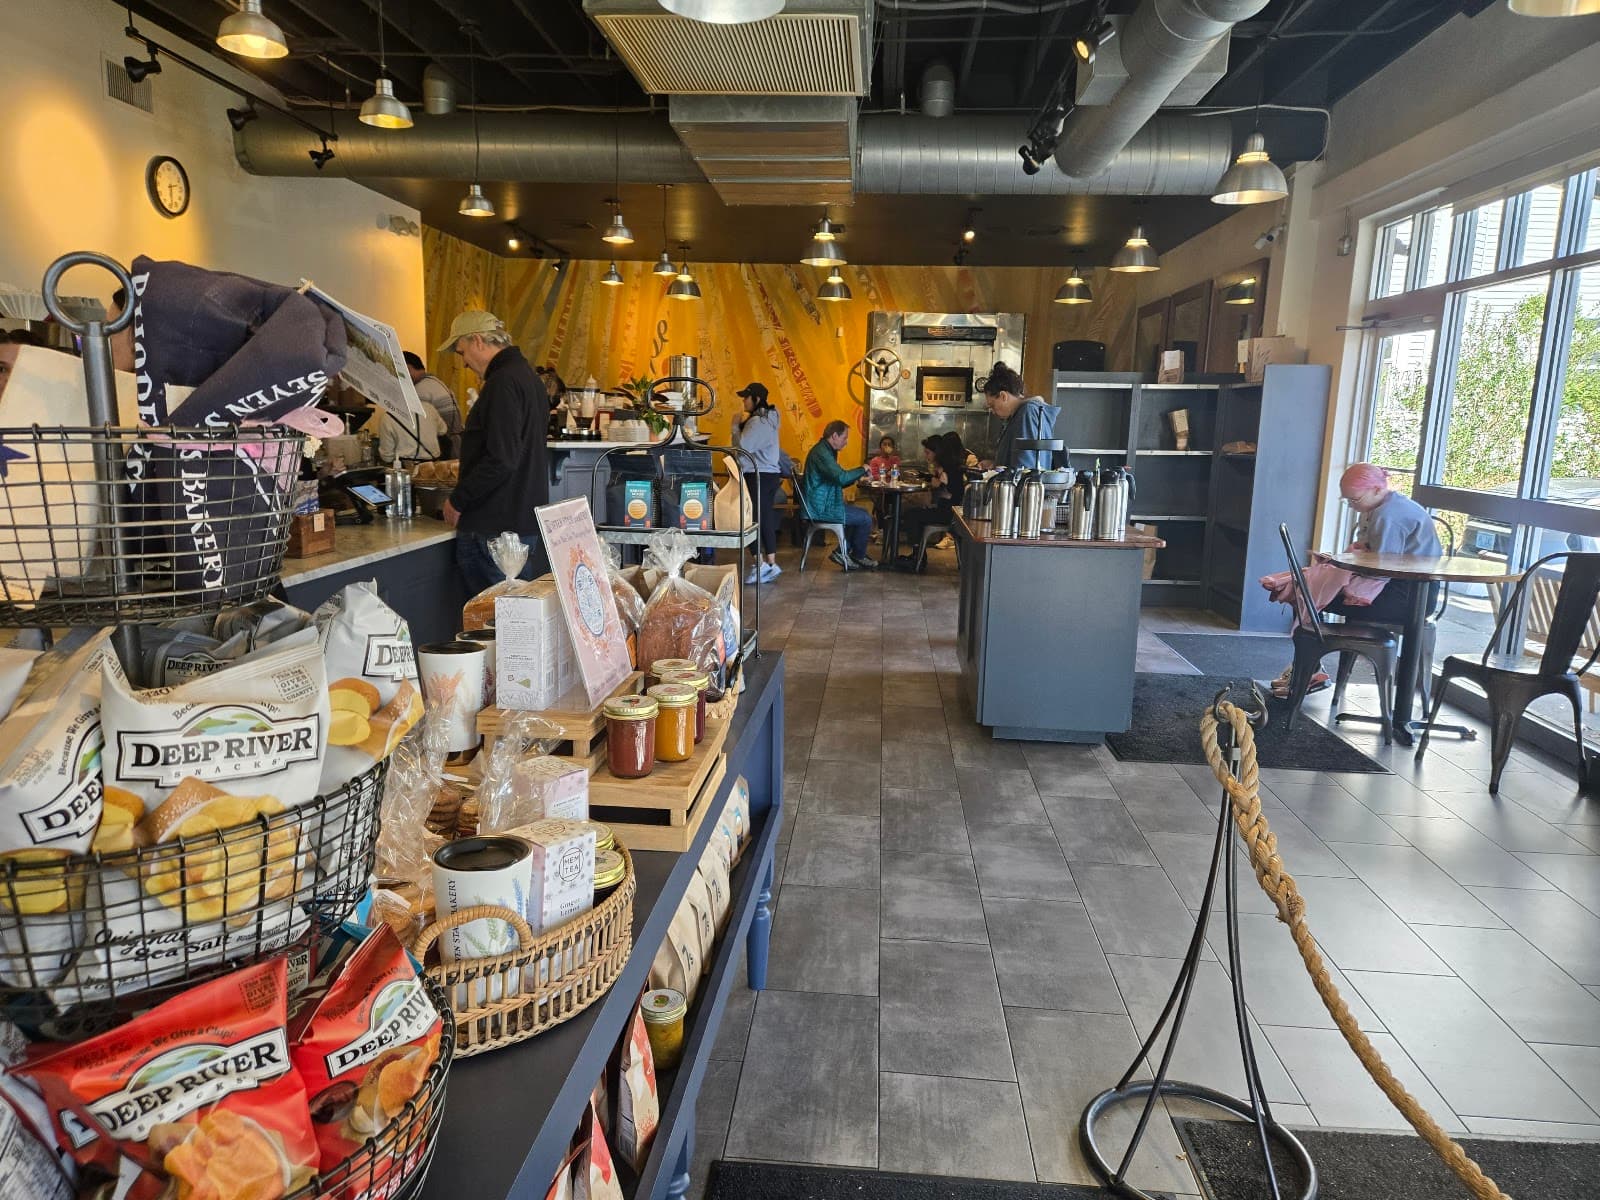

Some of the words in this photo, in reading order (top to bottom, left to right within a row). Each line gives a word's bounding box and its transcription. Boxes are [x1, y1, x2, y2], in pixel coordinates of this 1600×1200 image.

[225, 370, 328, 417] SEVEN
[181, 468, 227, 592] BAKERY
[167, 660, 193, 671] DEEP
[194, 662, 232, 673] RIVE
[256, 700, 281, 713] hip!
[58, 733, 74, 776] Because
[66, 721, 80, 735] We
[75, 708, 94, 724] Give
[131, 741, 220, 767] DEEP
[223, 727, 312, 760] RIVER
[564, 855, 579, 865] MEM
[564, 864, 579, 874] TEA
[94, 927, 192, 955] Original
[134, 947, 179, 962] Sea
[187, 935, 232, 954] Salt
[153, 1035, 169, 1047] We
[169, 1028, 195, 1042] Give
[336, 1020, 402, 1069] DEEP
[398, 990, 429, 1028] RIV
[176, 1041, 281, 1093] RIVER
